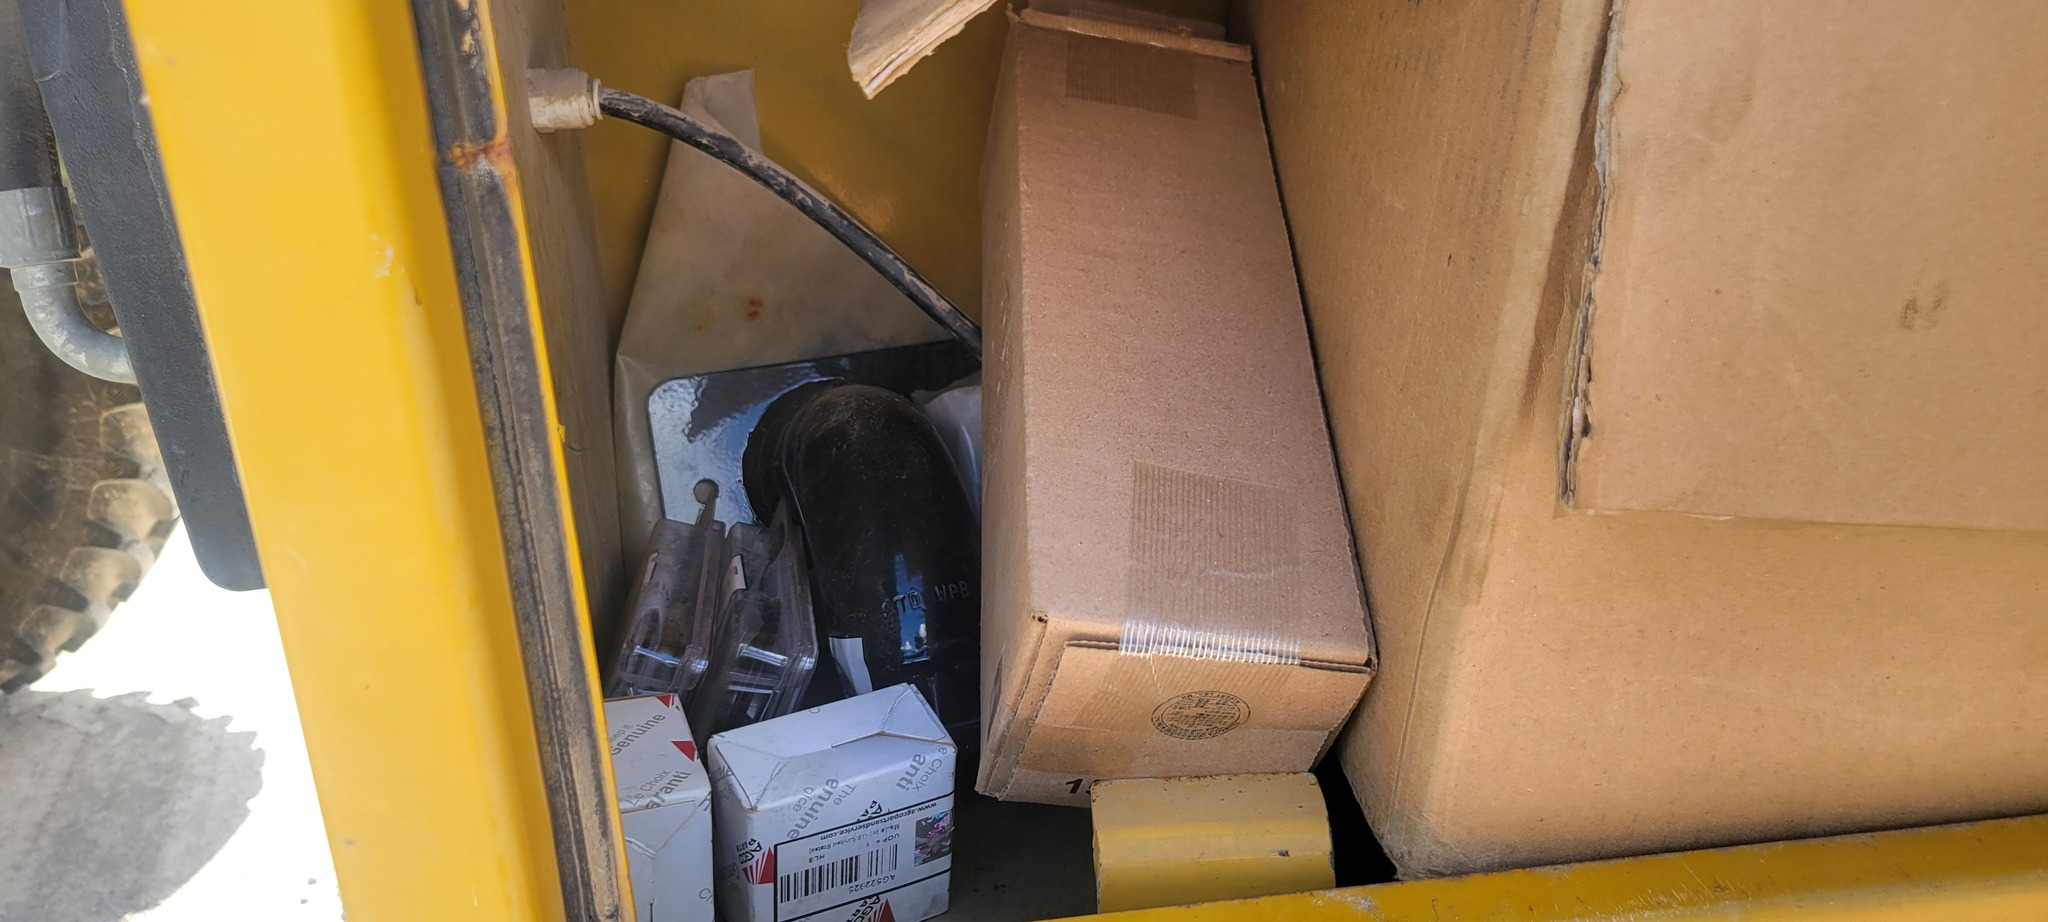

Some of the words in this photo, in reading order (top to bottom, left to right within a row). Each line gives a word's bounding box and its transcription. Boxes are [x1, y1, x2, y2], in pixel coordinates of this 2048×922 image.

[609, 728, 627, 743] eep
[610, 713, 667, 757] Genuine
[625, 792, 644, 807] Le
[639, 769, 672, 793] Choix
[645, 770, 692, 810] aranti
[894, 754, 926, 792] anti
[911, 757, 943, 793] Choix
[786, 777, 839, 840] enuine
[792, 786, 814, 813] oice
[833, 783, 857, 807] The
[820, 801, 938, 842] www.agcopartsandservice.com
[882, 832, 901, 843] UOP
[735, 837, 757, 853] PARTS
[853, 894, 881, 922] AGC
